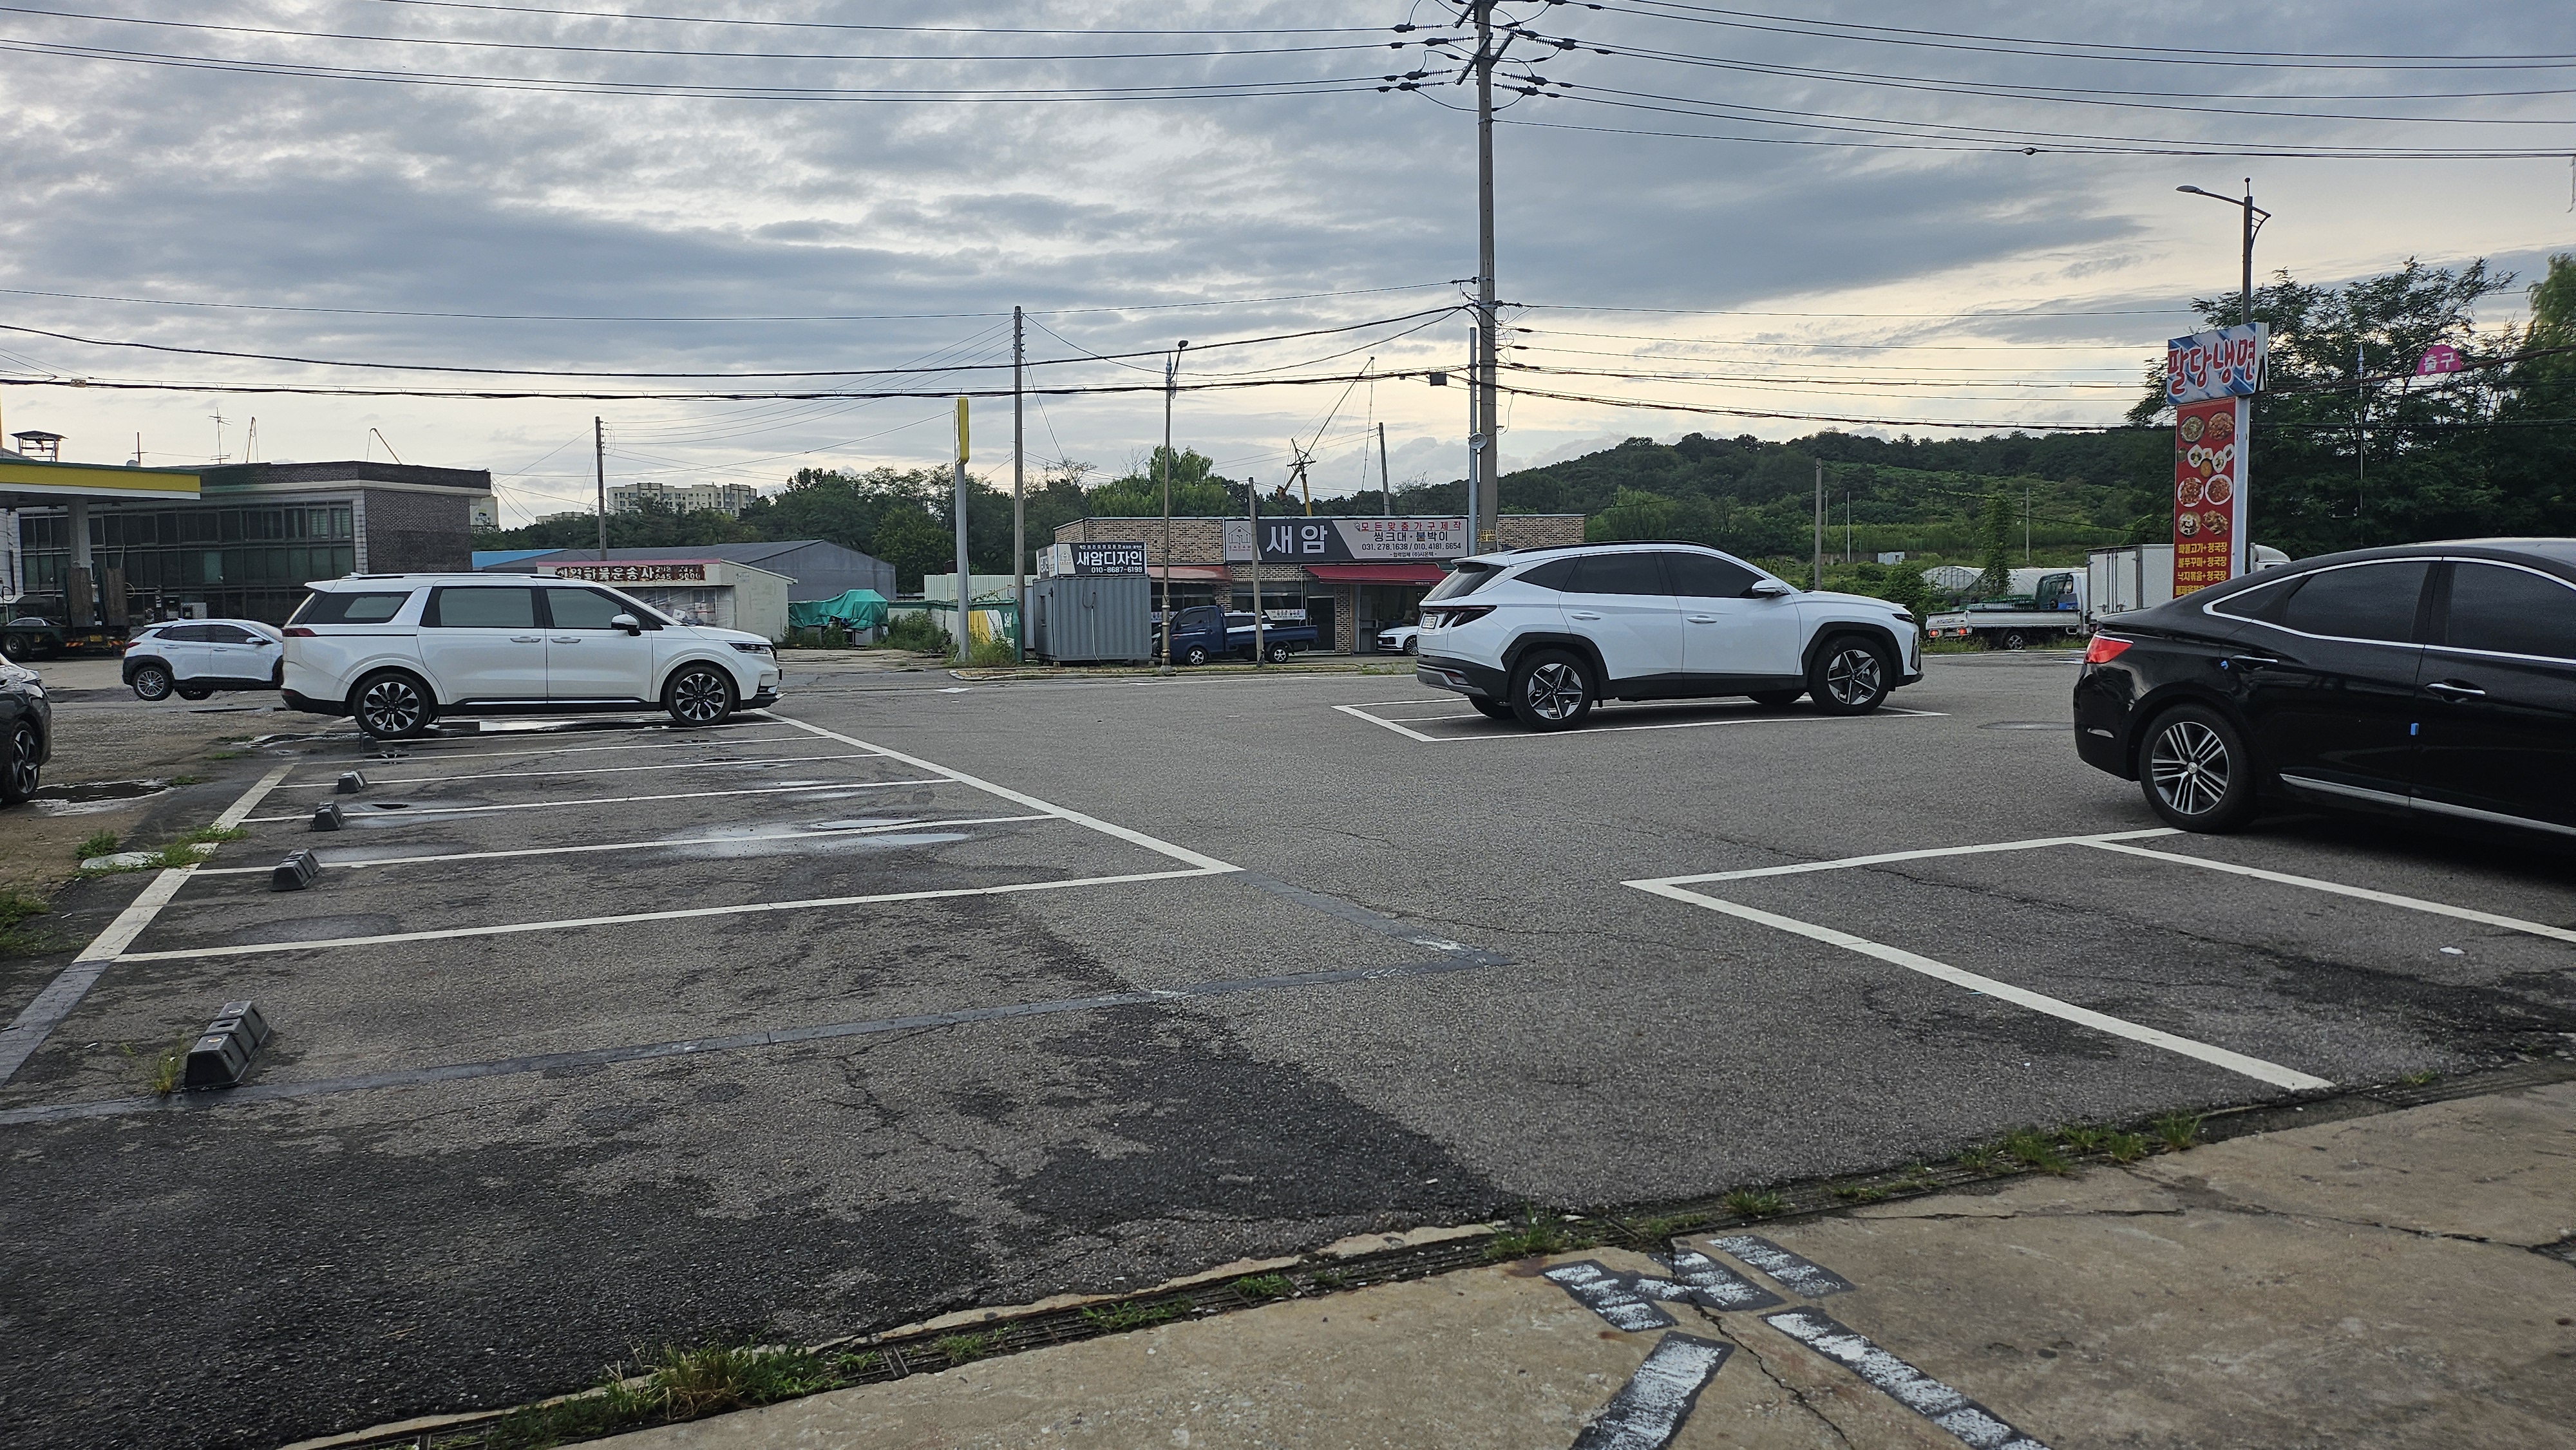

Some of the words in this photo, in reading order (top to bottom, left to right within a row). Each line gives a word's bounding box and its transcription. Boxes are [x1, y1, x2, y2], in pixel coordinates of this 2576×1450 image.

[2168, 335, 2256, 395] 팔당냉면
[2424, 352, 2455, 373] 출구
[1076, 551, 1142, 566] 새암디자인
